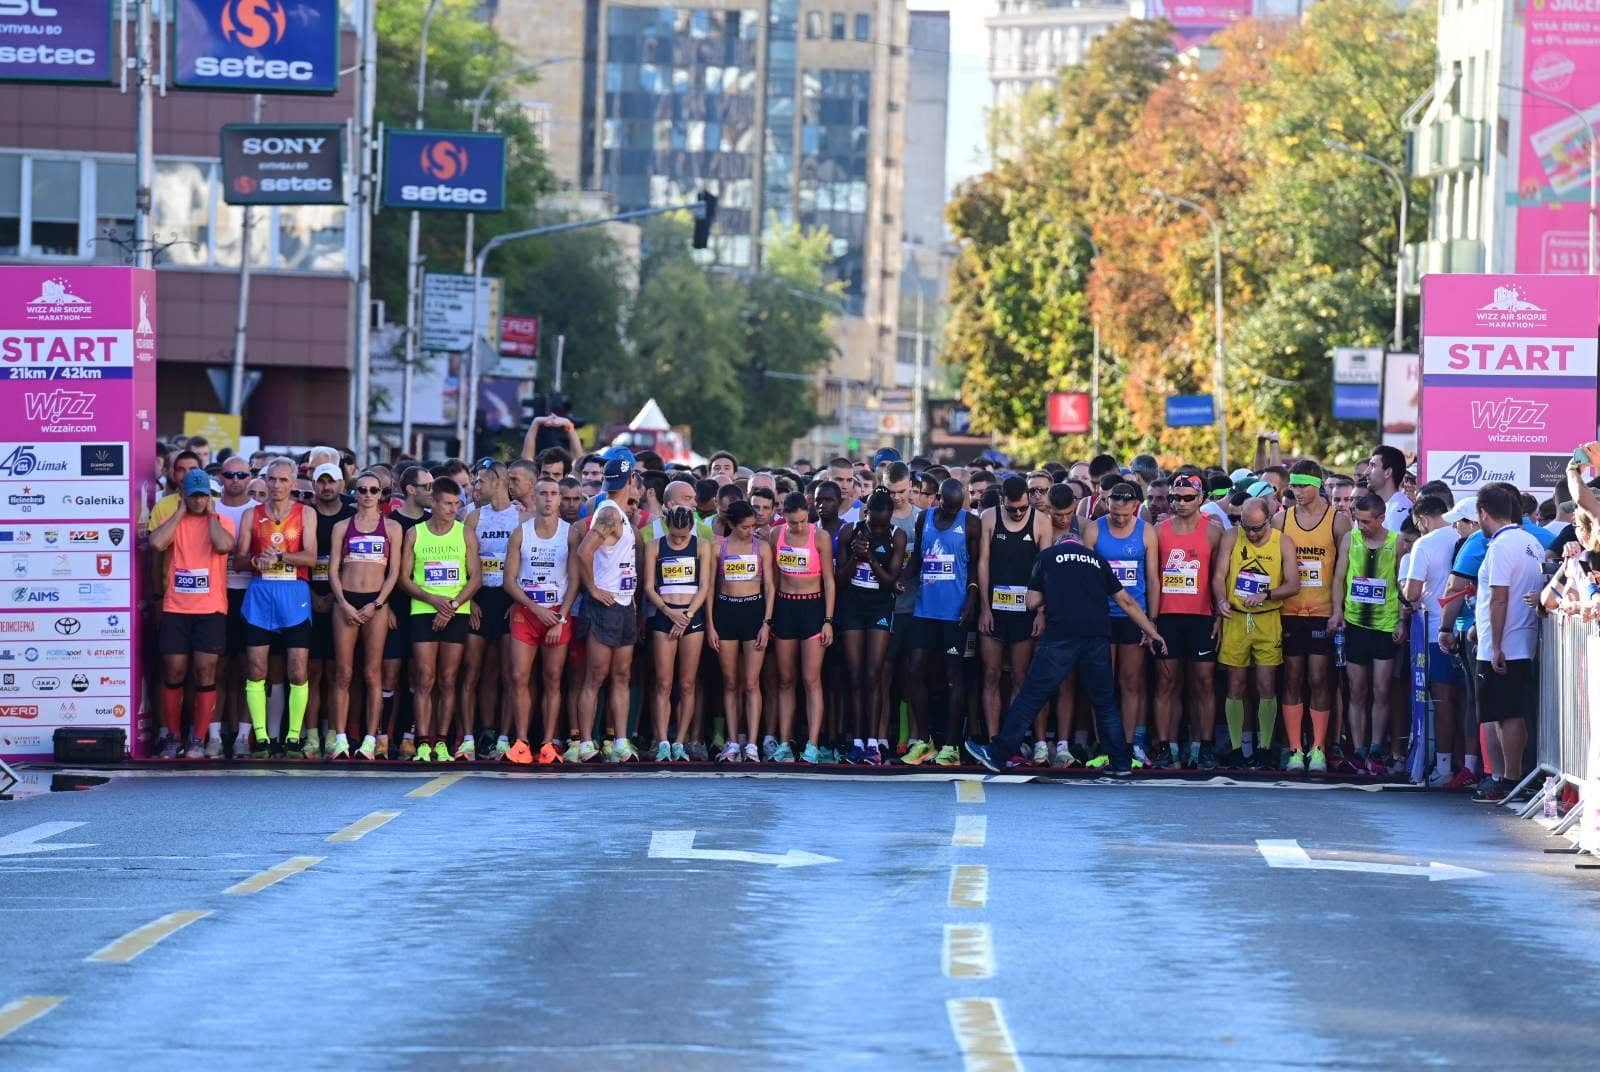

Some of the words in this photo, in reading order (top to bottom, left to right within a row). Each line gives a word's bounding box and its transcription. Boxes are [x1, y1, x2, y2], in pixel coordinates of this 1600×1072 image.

[0, 45, 96, 65] setec
[195, 56, 313, 80] setec
[242, 137, 326, 155] SONY
[261, 176, 333, 191] setec
[401, 184, 488, 204] setec
[1476, 312, 1499, 320] WIZZ
[2, 336, 118, 363] START
[1448, 344, 1574, 371] START
[9, 367, 47, 379] 21km
[61, 367, 102, 379] 42km
[41, 423, 97, 433] wizzair.com
[1488, 433, 1548, 443] wizzair.com
[37, 460, 68, 471] Limak
[1483, 470, 1516, 481] Limak
[75, 495, 125, 505] Galenika
[481, 531, 511, 539] ARMY
[779, 554, 797, 563] 2267
[1055, 553, 1101, 569] OFFICIAL
[663, 566, 682, 574] 1964
[178, 576, 193, 585] 200
[1164, 576, 1184, 584] 2255
[1244, 580, 1251, 588] 9
[1356, 585, 1369, 593] 195
[28, 592, 60, 602] AIMS
[998, 593, 1011, 601] 1311
[1, 706, 38, 716] VERO
[95, 707, 112, 715] total
